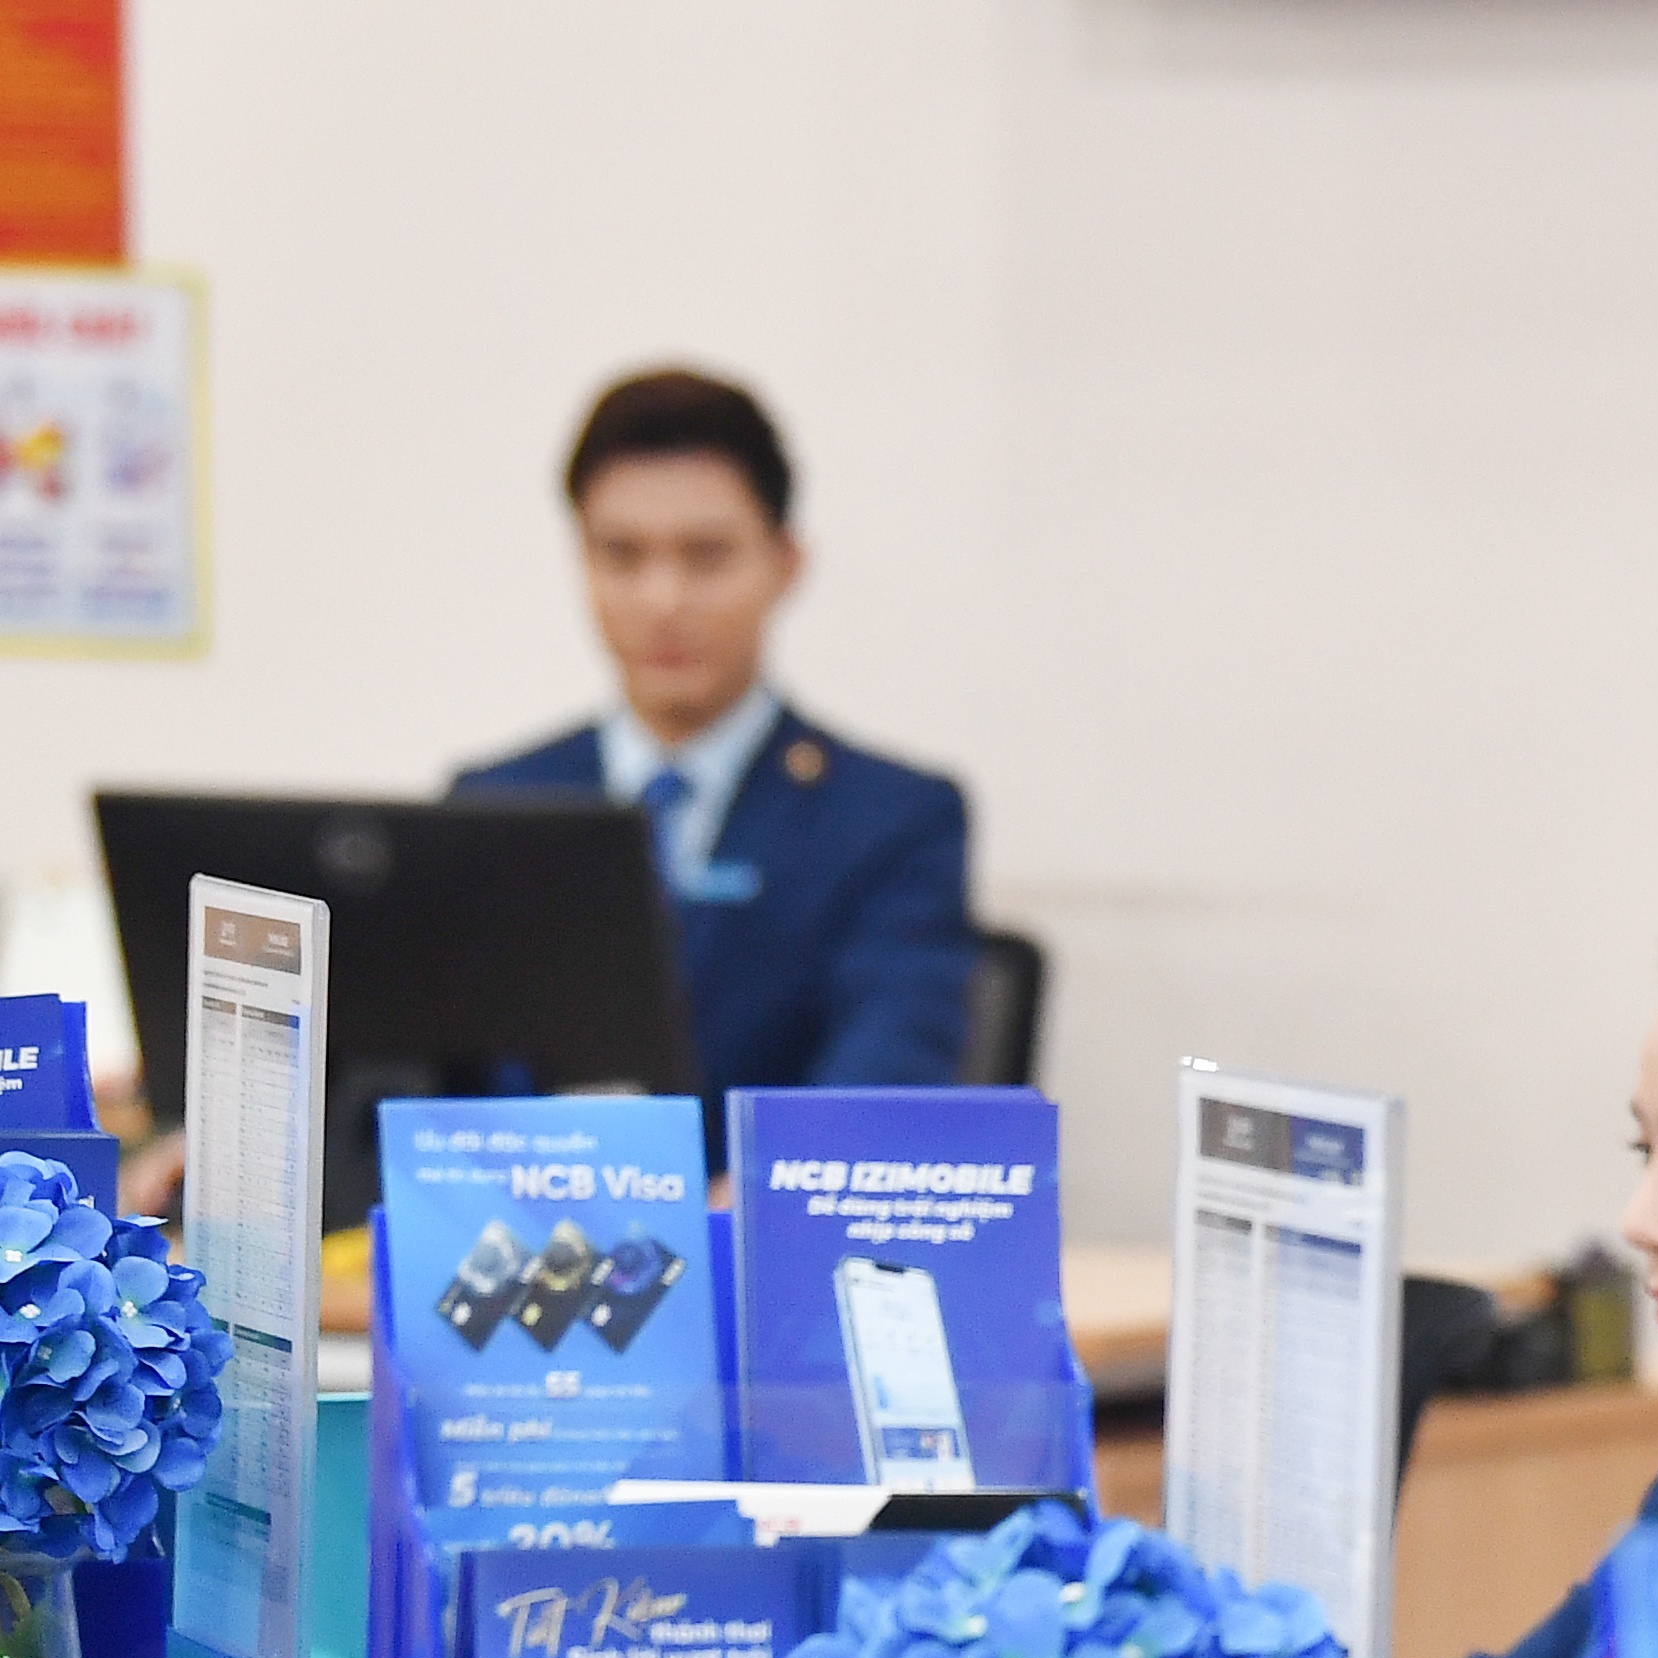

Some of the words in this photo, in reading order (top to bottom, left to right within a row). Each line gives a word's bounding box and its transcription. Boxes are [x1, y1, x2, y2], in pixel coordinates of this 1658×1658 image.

[510, 1163, 596, 1201] NCB
[601, 1163, 686, 1202] Visa
[768, 1158, 850, 1192] NCB
[850, 1160, 1035, 1197] IZIMOBILE
